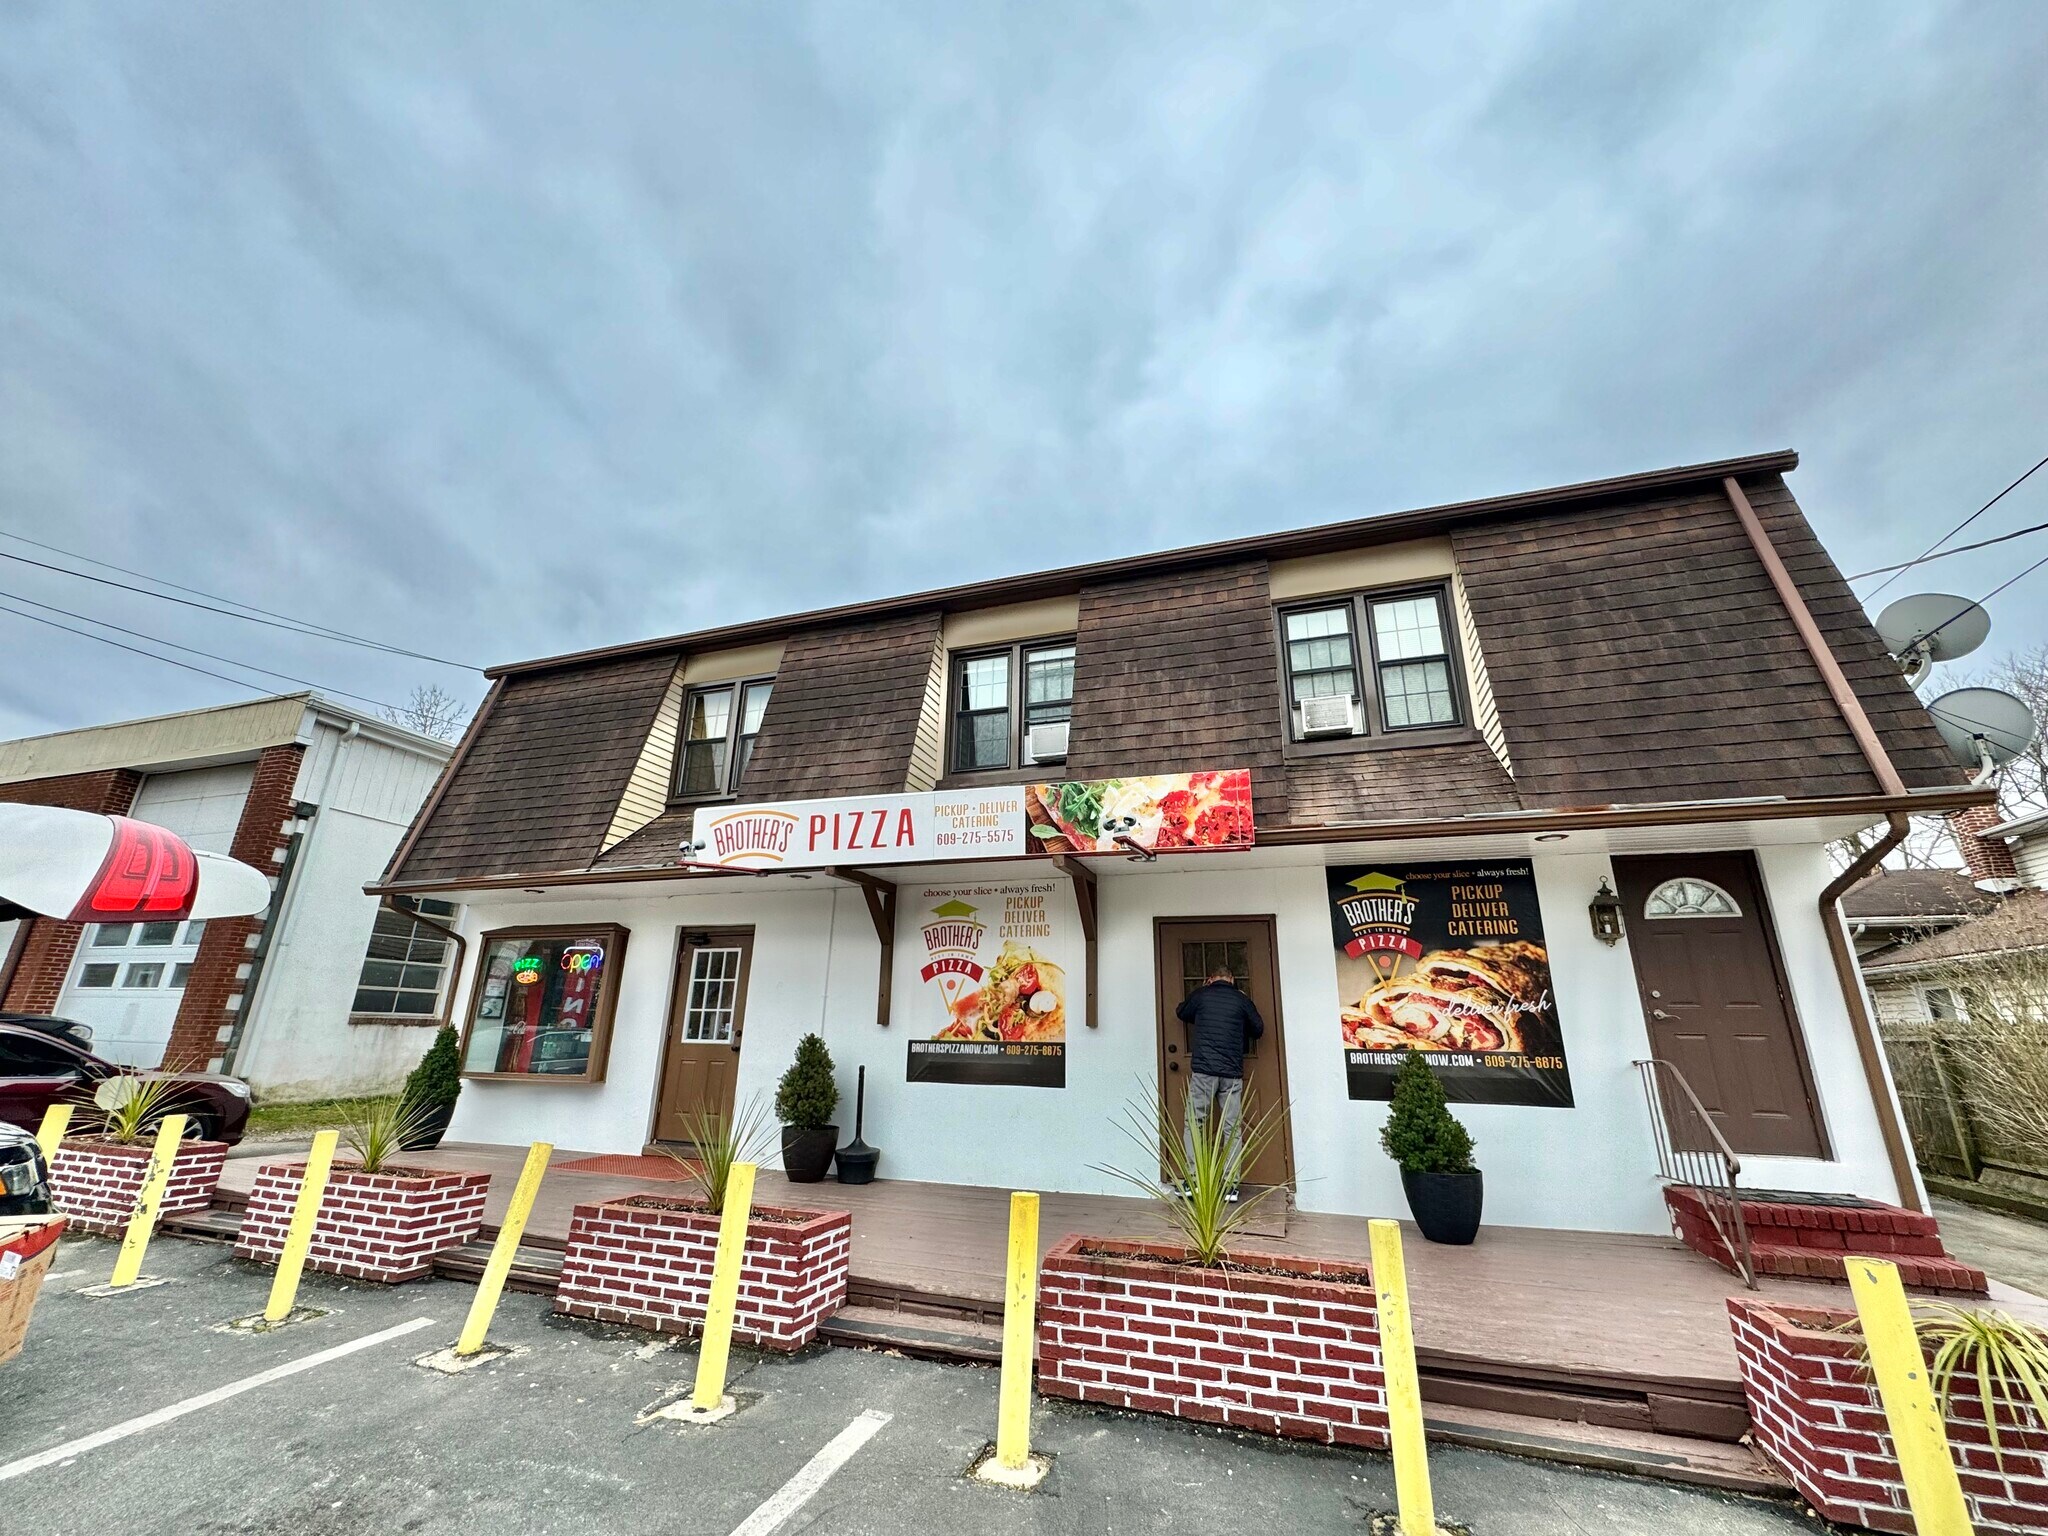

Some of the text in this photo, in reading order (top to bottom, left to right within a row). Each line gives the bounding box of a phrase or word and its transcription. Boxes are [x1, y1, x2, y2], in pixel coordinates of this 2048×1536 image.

[934, 800, 1018, 818] PICKUP DELIVER
[952, 814, 999, 829] CATERING
[713, 807, 915, 857] BROTHER'S PIZZA
[936, 829, 1014, 846] 609-275-5575
[1405, 867, 1529, 881] choose your slice always fresh!
[923, 883, 1056, 898] choose your slice always fresh!
[1451, 884, 1503, 900] PICKUP
[1006, 896, 1044, 910] PICKUP
[1452, 901, 1509, 918] DELIVER
[1004, 909, 1046, 924] DELIVER
[999, 923, 1050, 938] CATERING
[1447, 919, 1519, 936] CATERING
[1358, 934, 1407, 951] PIZZA
[932, 959, 973, 974] PIZZA
[1442, 989, 1552, 1023] deliver fresh
[911, 1042, 999, 1055] BROTHERSPIZZANOW.COM
